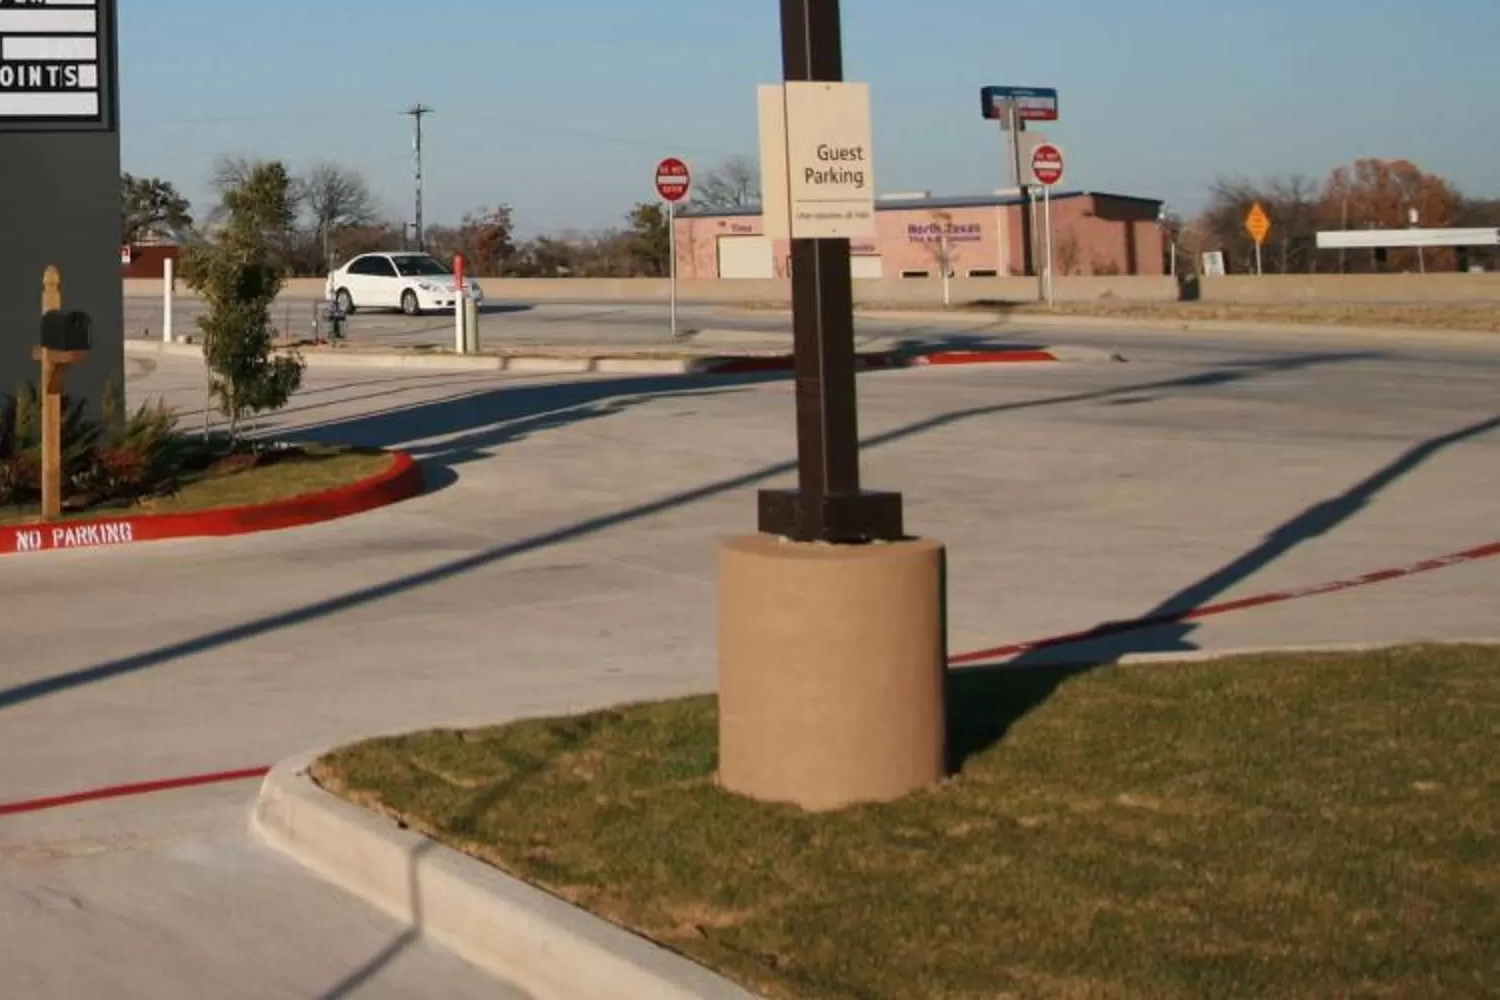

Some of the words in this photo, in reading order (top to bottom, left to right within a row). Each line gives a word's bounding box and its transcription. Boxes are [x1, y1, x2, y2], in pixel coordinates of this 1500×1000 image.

[816, 143, 865, 161] Guest
[804, 166, 865, 189] Parking
[16, 530, 41, 552] NO
[52, 522, 133, 548] PARKING
